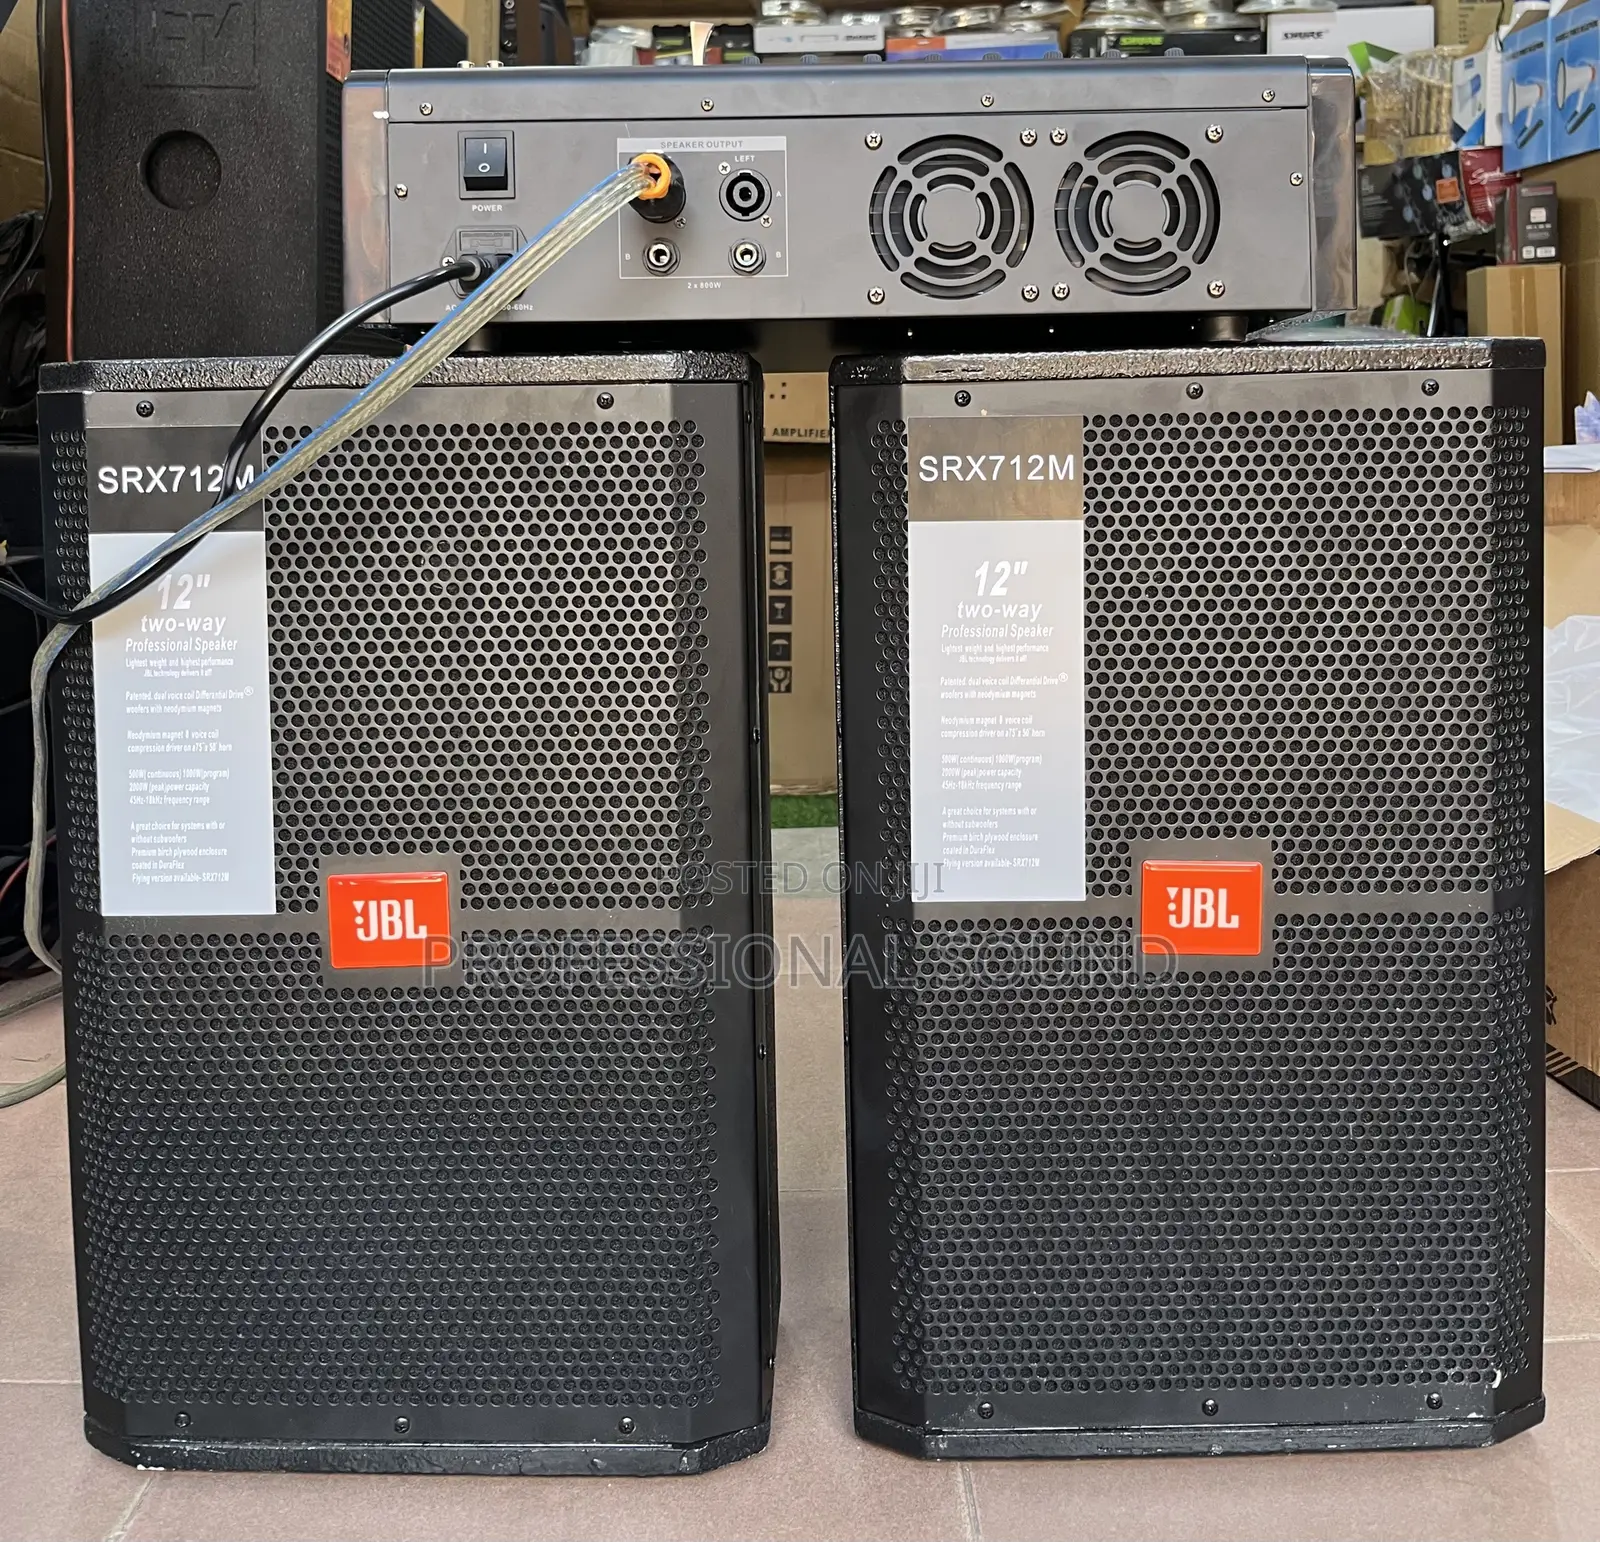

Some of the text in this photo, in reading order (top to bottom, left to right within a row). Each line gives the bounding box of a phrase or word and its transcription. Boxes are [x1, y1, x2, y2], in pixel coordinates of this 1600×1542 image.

[661, 140, 743, 149] SPEAKER OUTPUT
[734, 155, 755, 163] LEFT
[472, 204, 503, 212] POWER
[772, 427, 831, 438] AMPLIFIE
[919, 454, 1074, 482] SRX712M
[974, 561, 1029, 597] 12"
[157, 573, 211, 610] 12"
[957, 601, 1043, 622] two-way
[141, 615, 227, 637] two-way
[941, 623, 1054, 640] Professional Speaker
[125, 636, 238, 654] Professional Speaker
[965, 644, 982, 654] weight
[984, 644, 994, 652] and
[149, 657, 167, 669] weight
[169, 657, 179, 666] and
[968, 676, 981, 685] dual
[982, 677, 997, 685] voice
[998, 676, 1009, 685] coil
[154, 691, 167, 700] dual
[167, 691, 183, 700] voice
[184, 690, 195, 700] coil
[964, 690, 977, 699] with
[1011, 690, 1036, 700] magnets
[150, 704, 162, 713] with
[198, 704, 222, 715] magnets
[1005, 716, 1020, 724] voice
[1021, 715, 1033, 724] coil
[162, 730, 184, 741] magnet
[191, 729, 207, 739] voice
[208, 729, 219, 739] coil
[940, 728, 978, 740] compression
[979, 728, 996, 738] driver
[127, 743, 165, 754] compression
[166, 743, 183, 752] driver
[976, 780, 1004, 791] frequency
[1005, 782, 1022, 791] range
[164, 795, 192, 806] frequency
[193, 797, 210, 806] range
[942, 807, 947, 815] A
[947, 807, 962, 817] great
[963, 806, 982, 815] choice
[983, 806, 992, 815] for
[992, 807, 1016, 817] systems
[1030, 807, 1037, 815] or
[130, 821, 135, 830] A
[136, 822, 151, 832] great
[151, 821, 170, 830] choice
[171, 820, 180, 830] for
[181, 822, 205, 832] systems
[984, 832, 1009, 843] plywood
[1009, 832, 1038, 841] enclosure
[173, 847, 198, 858] plywood
[198, 847, 227, 856] enclosure
[942, 845, 962, 855] coated
[132, 860, 151, 870] coated
[1167, 886, 1240, 930] JBL
[353, 899, 428, 942] JBL
